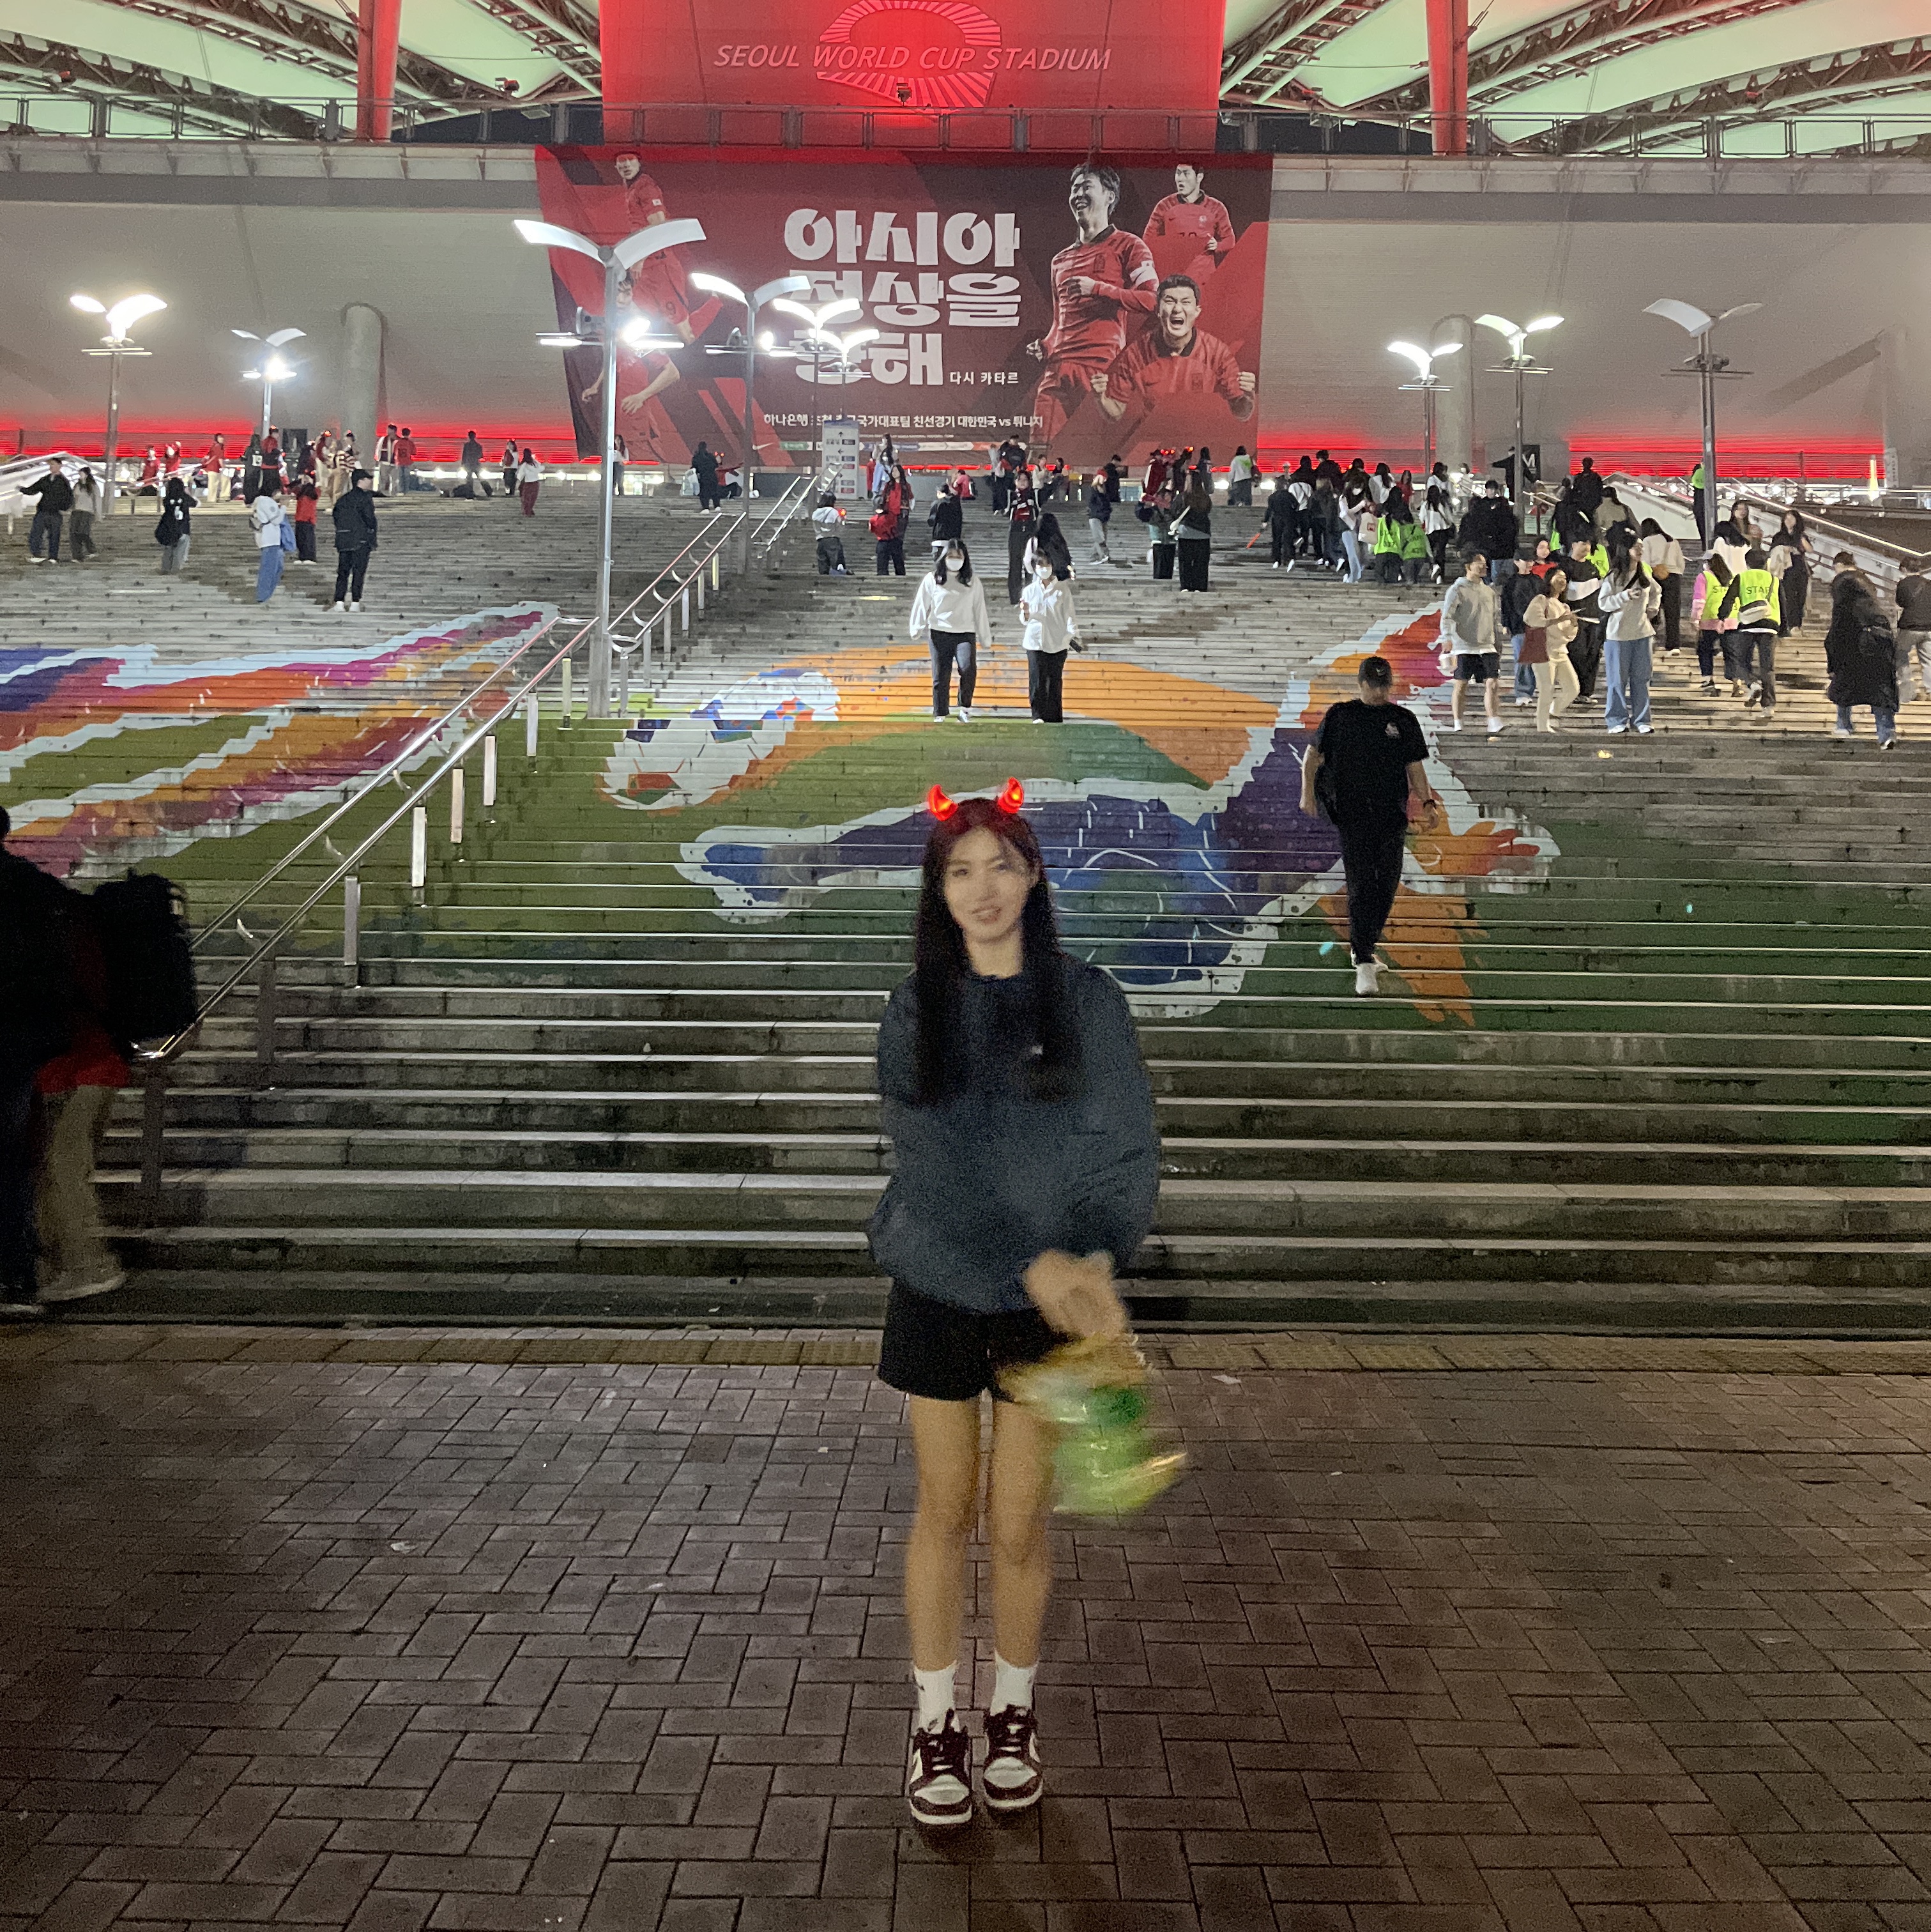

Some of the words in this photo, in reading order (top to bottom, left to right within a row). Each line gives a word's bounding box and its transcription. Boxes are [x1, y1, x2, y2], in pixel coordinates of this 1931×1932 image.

[714, 45, 799, 68] SEOUL
[813, 45, 910, 69] WORLD
[919, 47, 976, 70] CUP
[983, 47, 1111, 70] STADIUM
[784, 208, 1020, 267] 아시아
[950, 371, 974, 385] 다시
[981, 371, 1019, 385] 카타르
[763, 413, 808, 427] 하나은행
[913, 415, 955, 428] 친선경기
[958, 415, 996, 428] 대한민국
[998, 418, 1011, 427] vs
[1013, 415, 1043, 428] 튀니지
